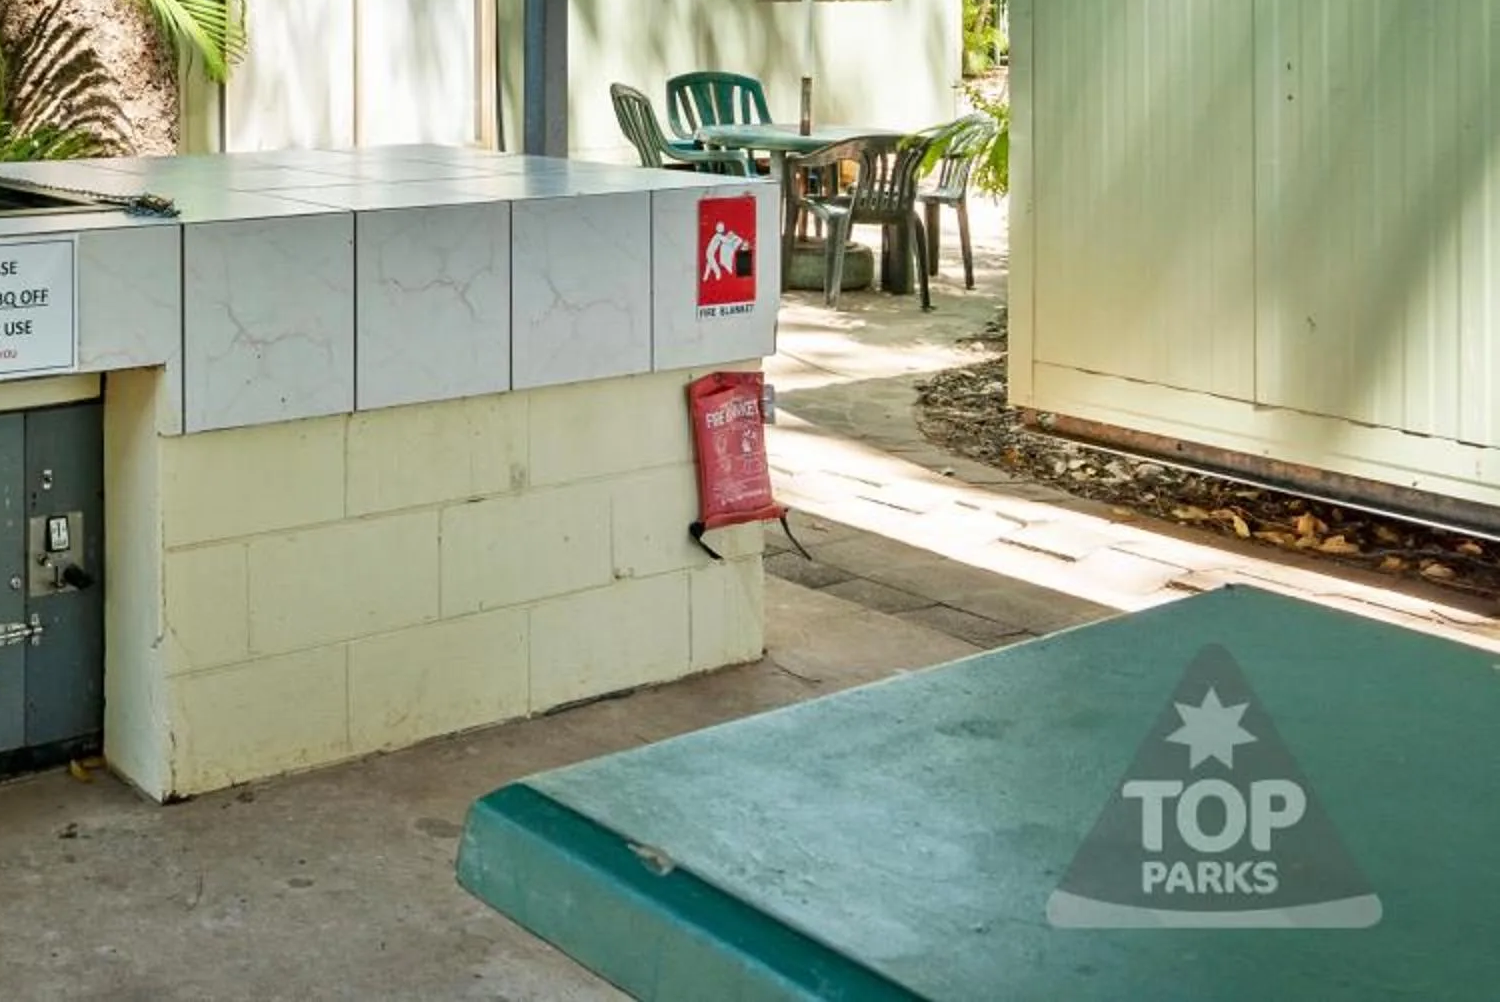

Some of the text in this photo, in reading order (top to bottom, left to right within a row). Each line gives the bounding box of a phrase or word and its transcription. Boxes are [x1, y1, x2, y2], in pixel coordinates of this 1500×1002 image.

[20, 289, 49, 305] OFF
[699, 303, 755, 318] FIRE BLANKET
[4, 320, 33, 336] USE
